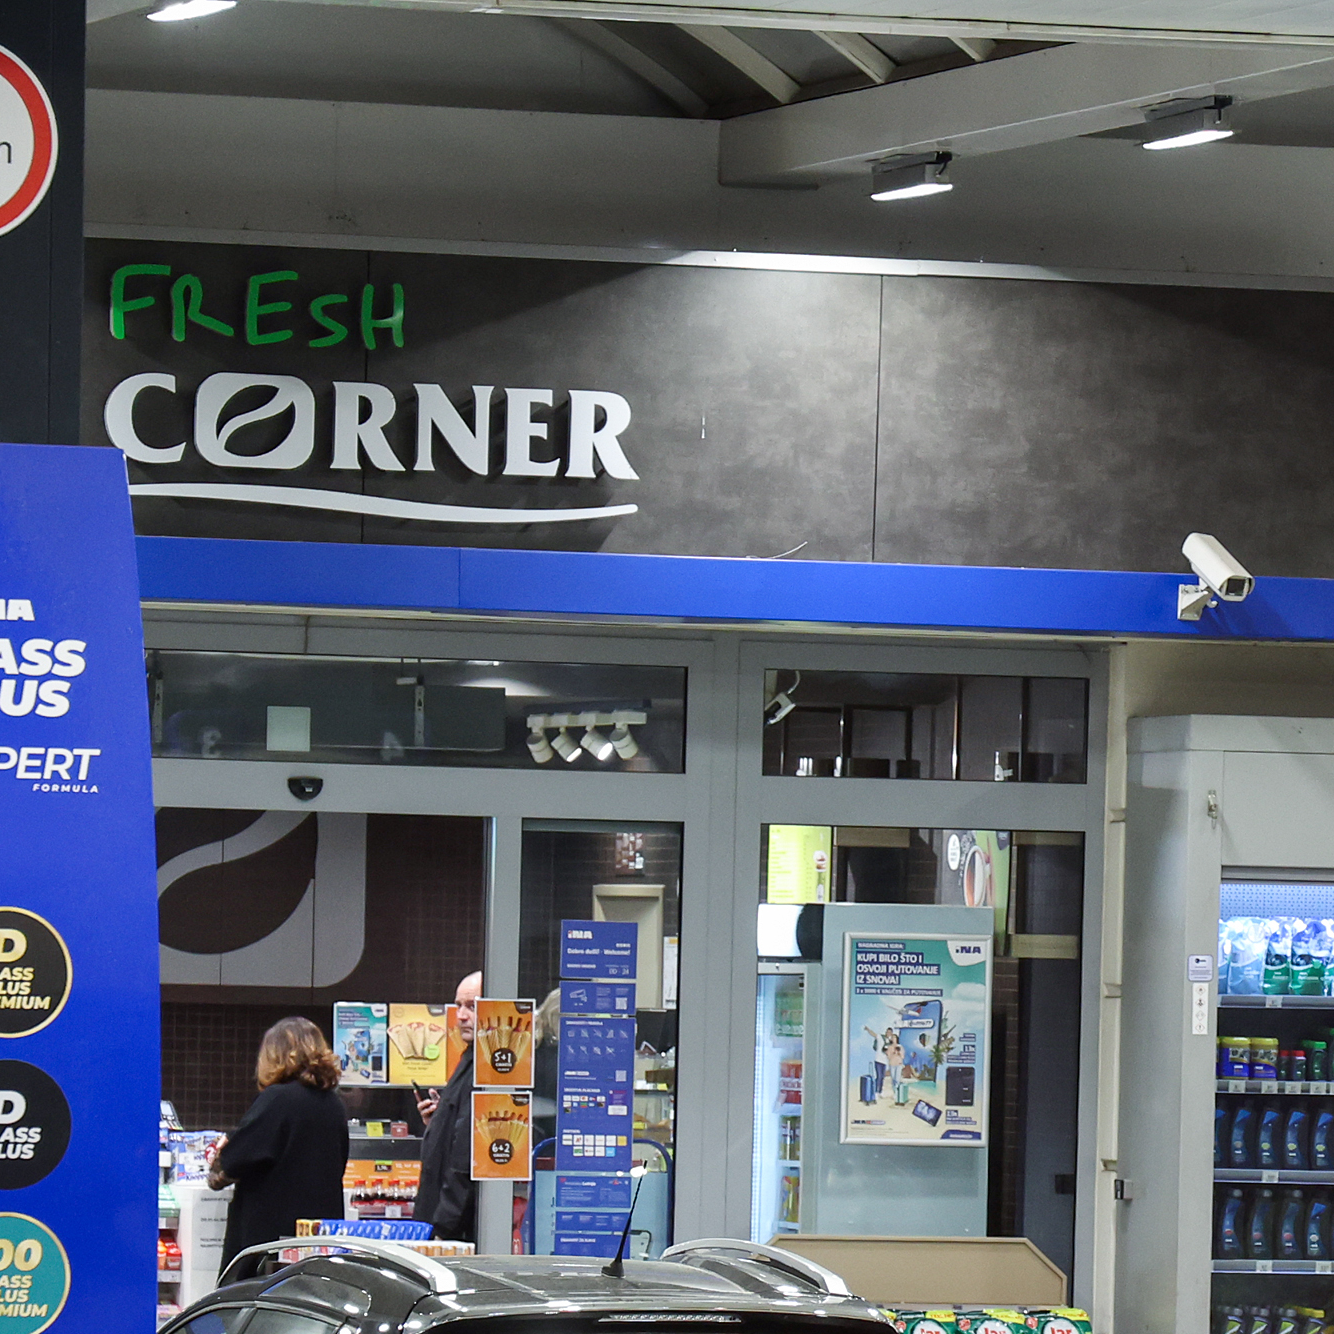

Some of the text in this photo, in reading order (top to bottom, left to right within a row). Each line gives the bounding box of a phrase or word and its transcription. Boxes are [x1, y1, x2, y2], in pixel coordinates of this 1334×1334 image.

[108, 263, 405, 350] FRESH
[103, 371, 641, 481] CORNER
[31, 783, 99, 794] FORMULA
[955, 945, 982, 955] INA
[857, 953, 878, 962] KUPI
[879, 953, 899, 963] BILO
[900, 952, 918, 963] ŠTO
[856, 963, 939, 974] OSVOJI PUTOVANJE
[856, 975, 865, 984] IZ
[492, 1143, 510, 1153] 6+2
